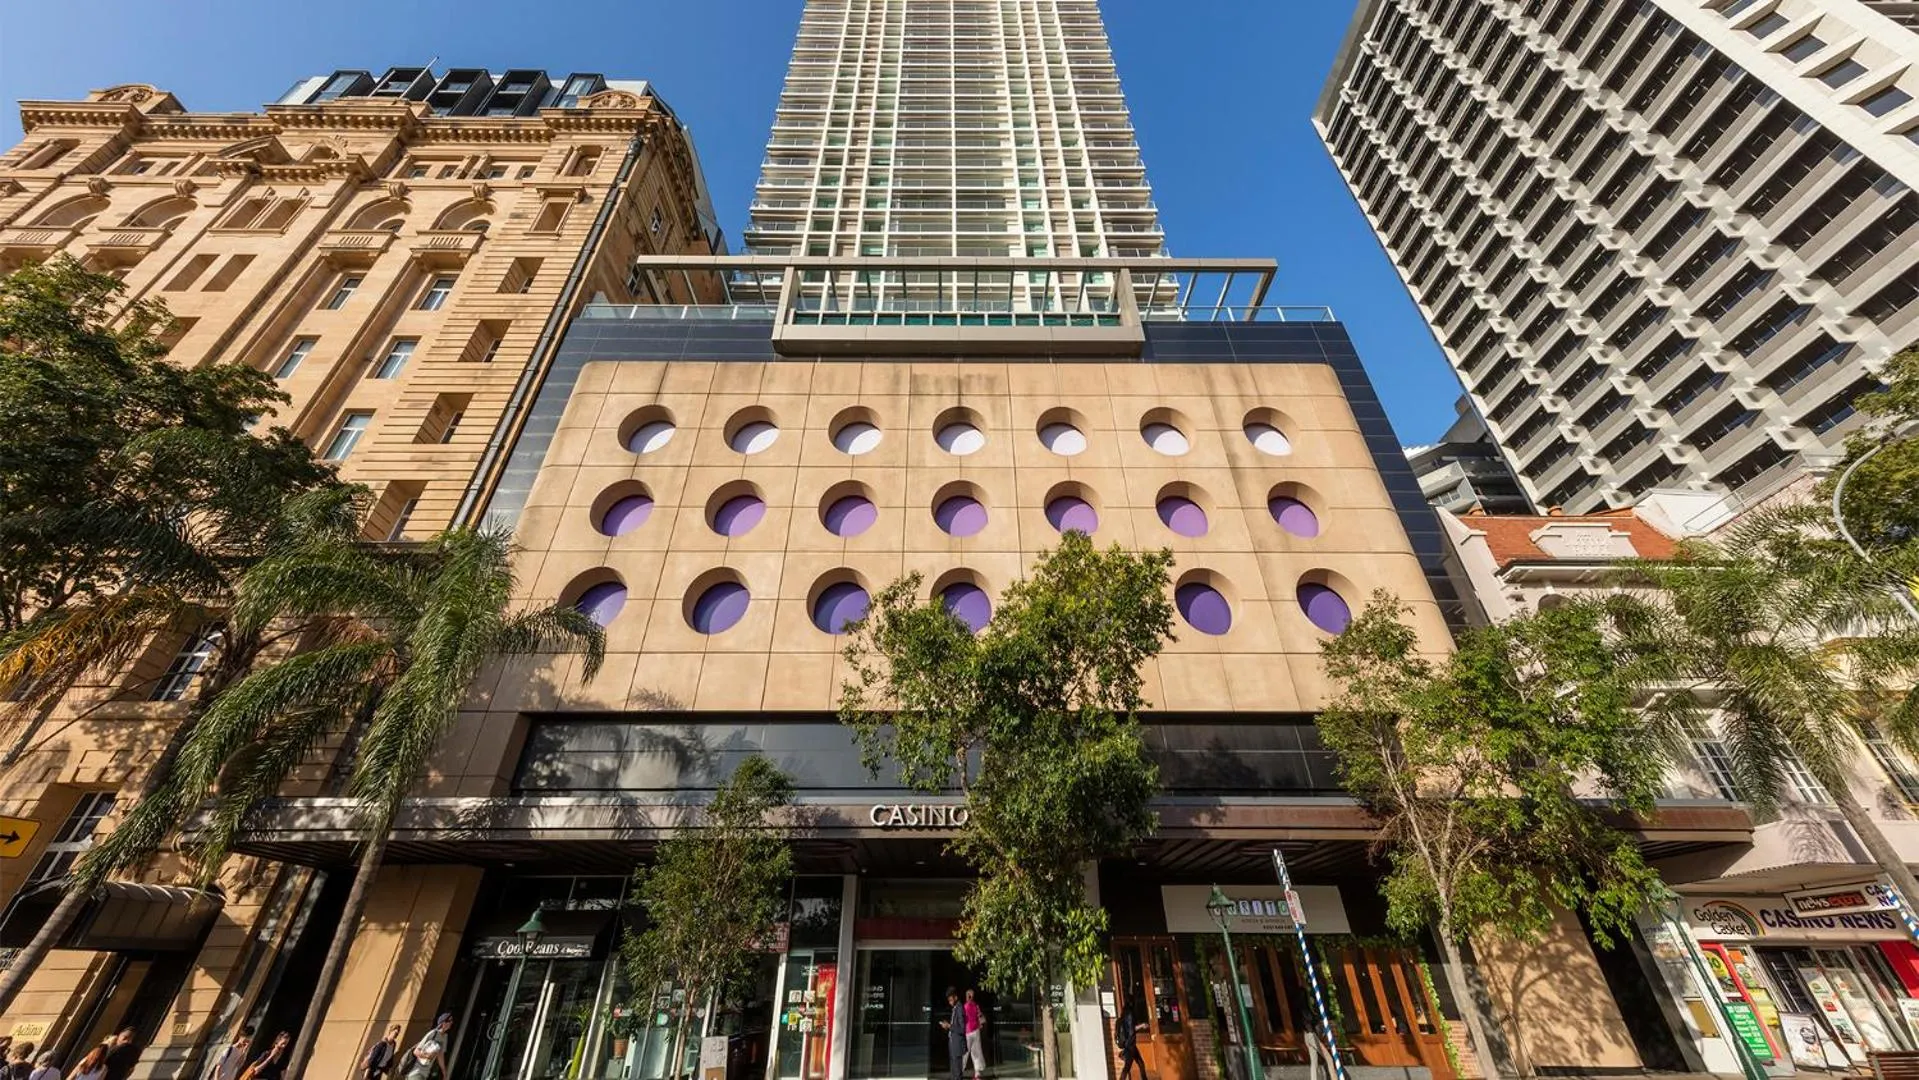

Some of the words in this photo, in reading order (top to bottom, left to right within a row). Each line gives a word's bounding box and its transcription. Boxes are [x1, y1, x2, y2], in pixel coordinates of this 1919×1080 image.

[870, 804, 969, 826] CASINO
[1694, 906, 1734, 922] Golden
[1840, 911, 1897, 930] NEWS
[1711, 923, 1751, 936] Casket
